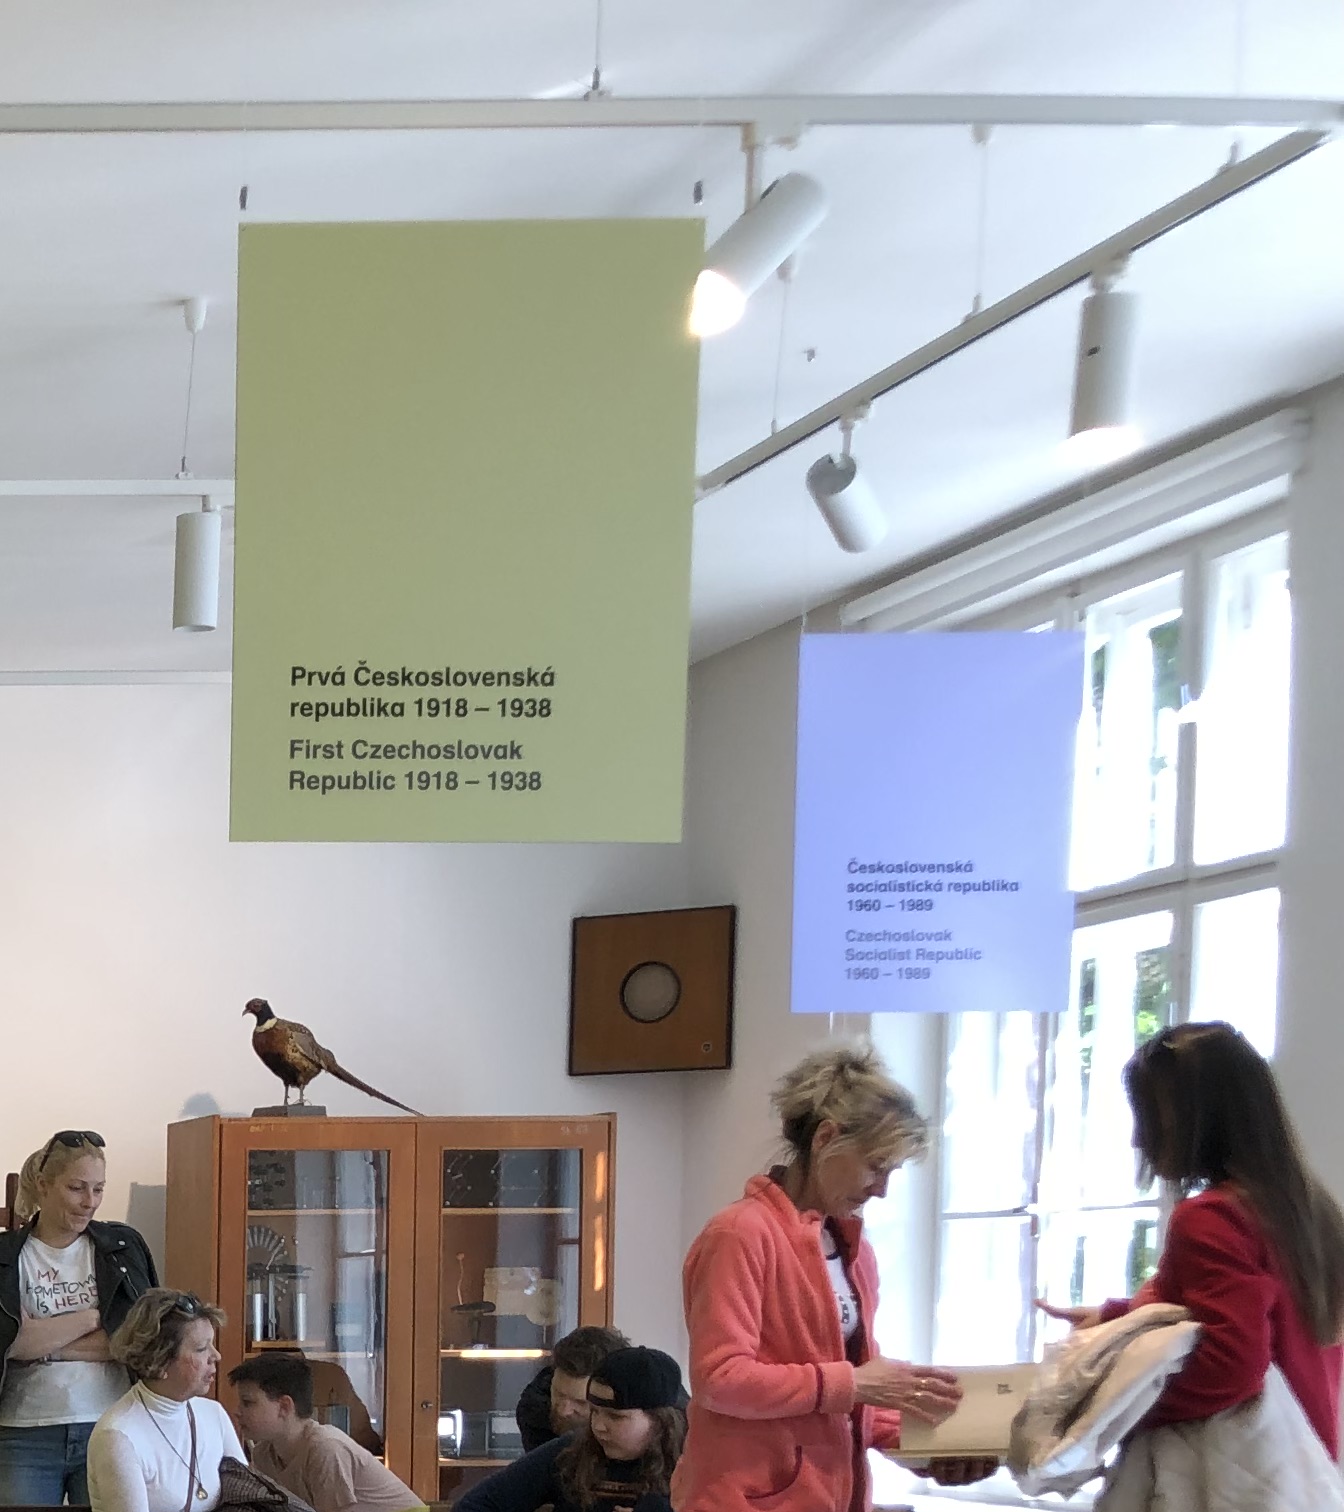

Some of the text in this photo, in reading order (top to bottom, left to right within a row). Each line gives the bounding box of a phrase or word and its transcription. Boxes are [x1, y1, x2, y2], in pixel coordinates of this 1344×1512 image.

[291, 660, 554, 687] Prvá Československá
[290, 697, 404, 722] republika
[413, 697, 468, 717] 1918
[497, 697, 551, 718] 1938
[289, 738, 523, 760] First Czechoslovak
[289, 769, 395, 795] Republic
[404, 770, 458, 790] 1918
[487, 770, 541, 791] 1938
[847, 857, 973, 874] Československá
[846, 879, 1019, 895] socialistická republika
[847, 898, 881, 911] 1960
[899, 898, 933, 911] 1989
[845, 928, 952, 942] Czechoslovak
[844, 947, 983, 963] Socialist Republic
[844, 967, 879, 980] 1960
[897, 967, 931, 979] 1989
[38, 1267, 59, 1282] MY
[36, 1286, 98, 1313] IS HERE
